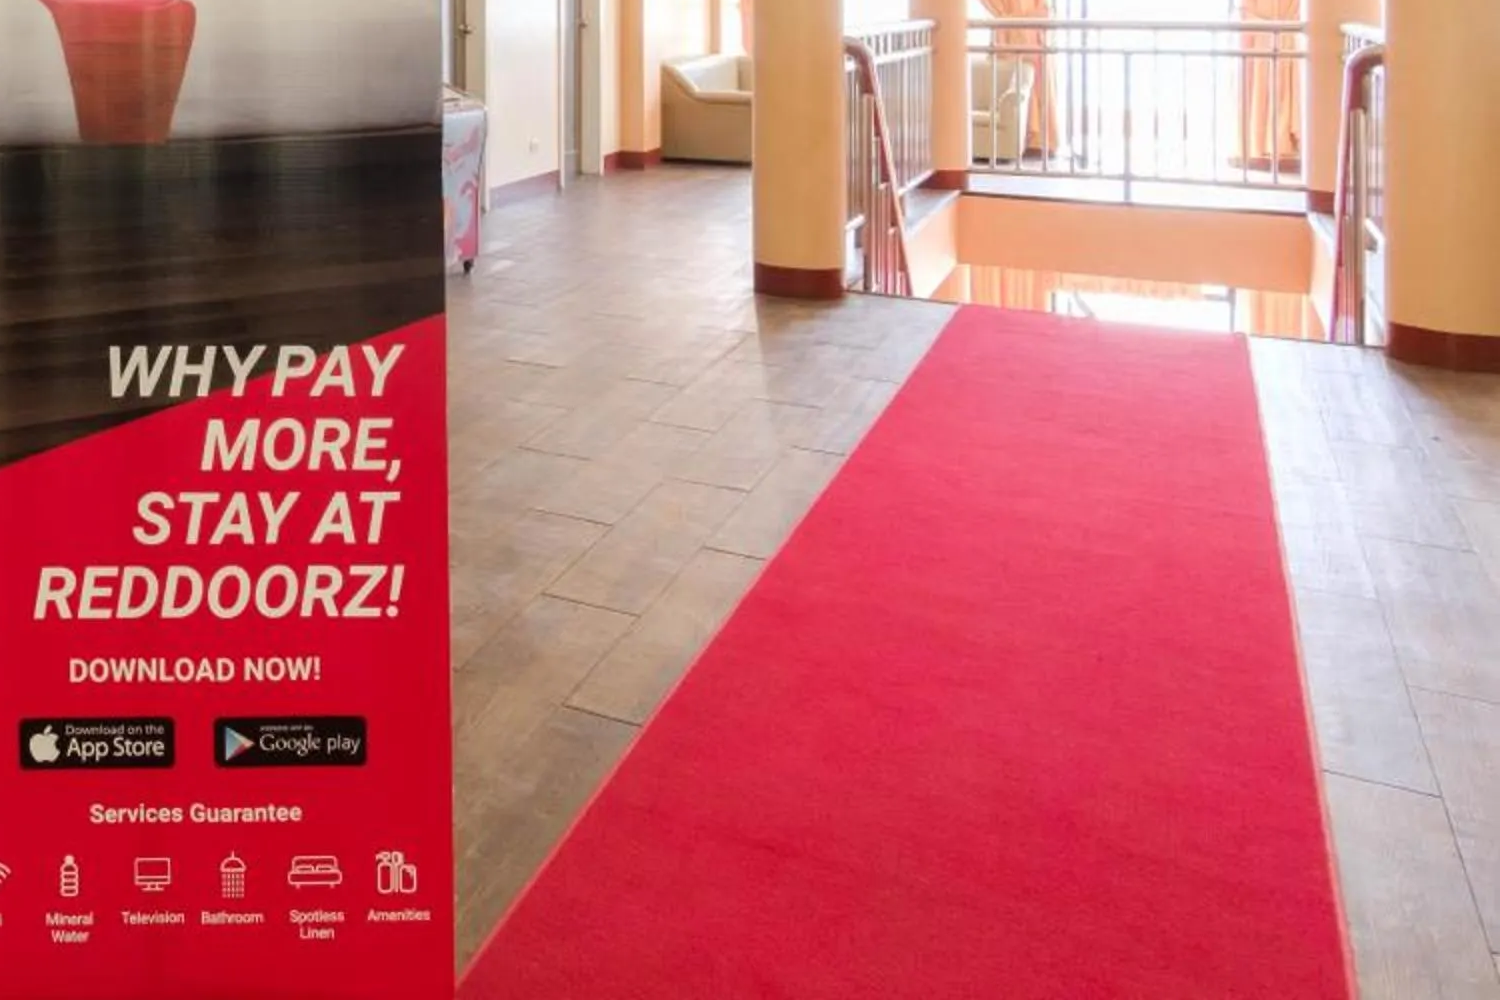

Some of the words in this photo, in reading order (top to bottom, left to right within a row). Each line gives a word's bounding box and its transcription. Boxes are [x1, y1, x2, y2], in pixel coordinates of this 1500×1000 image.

[109, 344, 264, 398] WHY
[271, 343, 405, 398] PAY
[200, 417, 402, 482] MORE,
[132, 491, 301, 546] STAY
[309, 491, 401, 545] AT
[33, 564, 405, 620] REDDOORZ!
[69, 657, 235, 683] DOWNLOAD
[243, 656, 321, 682] NOW!
[65, 724, 122, 736] Download
[127, 726, 143, 735] on
[147, 724, 165, 735] the
[66, 737, 109, 762] App
[112, 736, 165, 757] Store
[259, 732, 321, 757] Google
[326, 733, 361, 755] play
[89, 803, 183, 824] Services
[189, 803, 303, 823] Guarantee
[45, 912, 94, 926] Mineral
[121, 910, 185, 925] Television
[201, 910, 264, 925] Bathroom
[289, 909, 345, 927] Spotless
[367, 908, 431, 922] Amenities
[51, 929, 90, 943] Water
[299, 927, 335, 940] Linen
